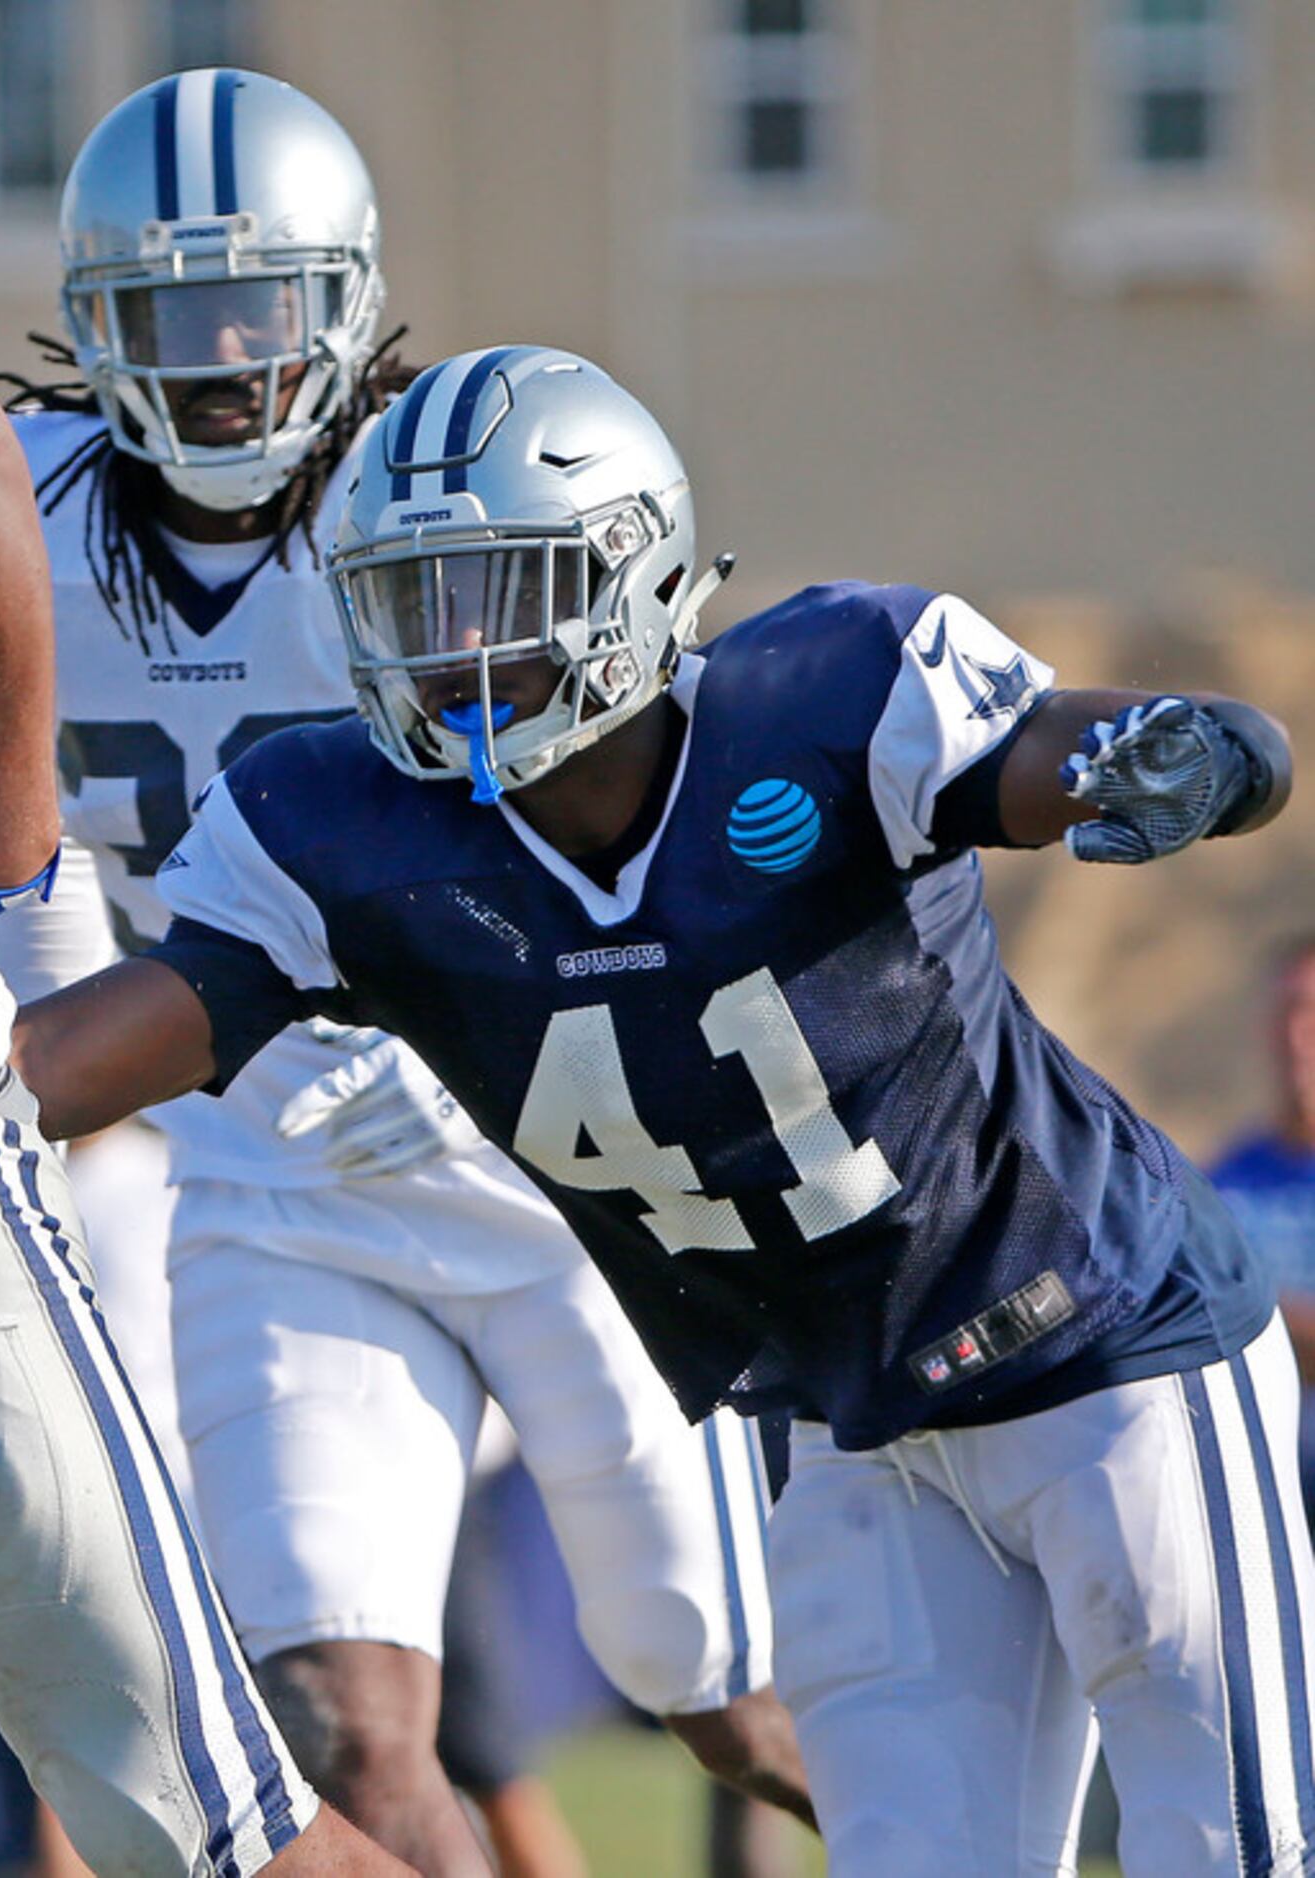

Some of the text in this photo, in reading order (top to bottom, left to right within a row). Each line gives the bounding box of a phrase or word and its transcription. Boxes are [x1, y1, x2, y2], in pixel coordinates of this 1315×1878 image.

[149, 661, 247, 682] COWBOYS
[556, 943, 667, 978] COWBOYS
[512, 966, 902, 1256] 41
